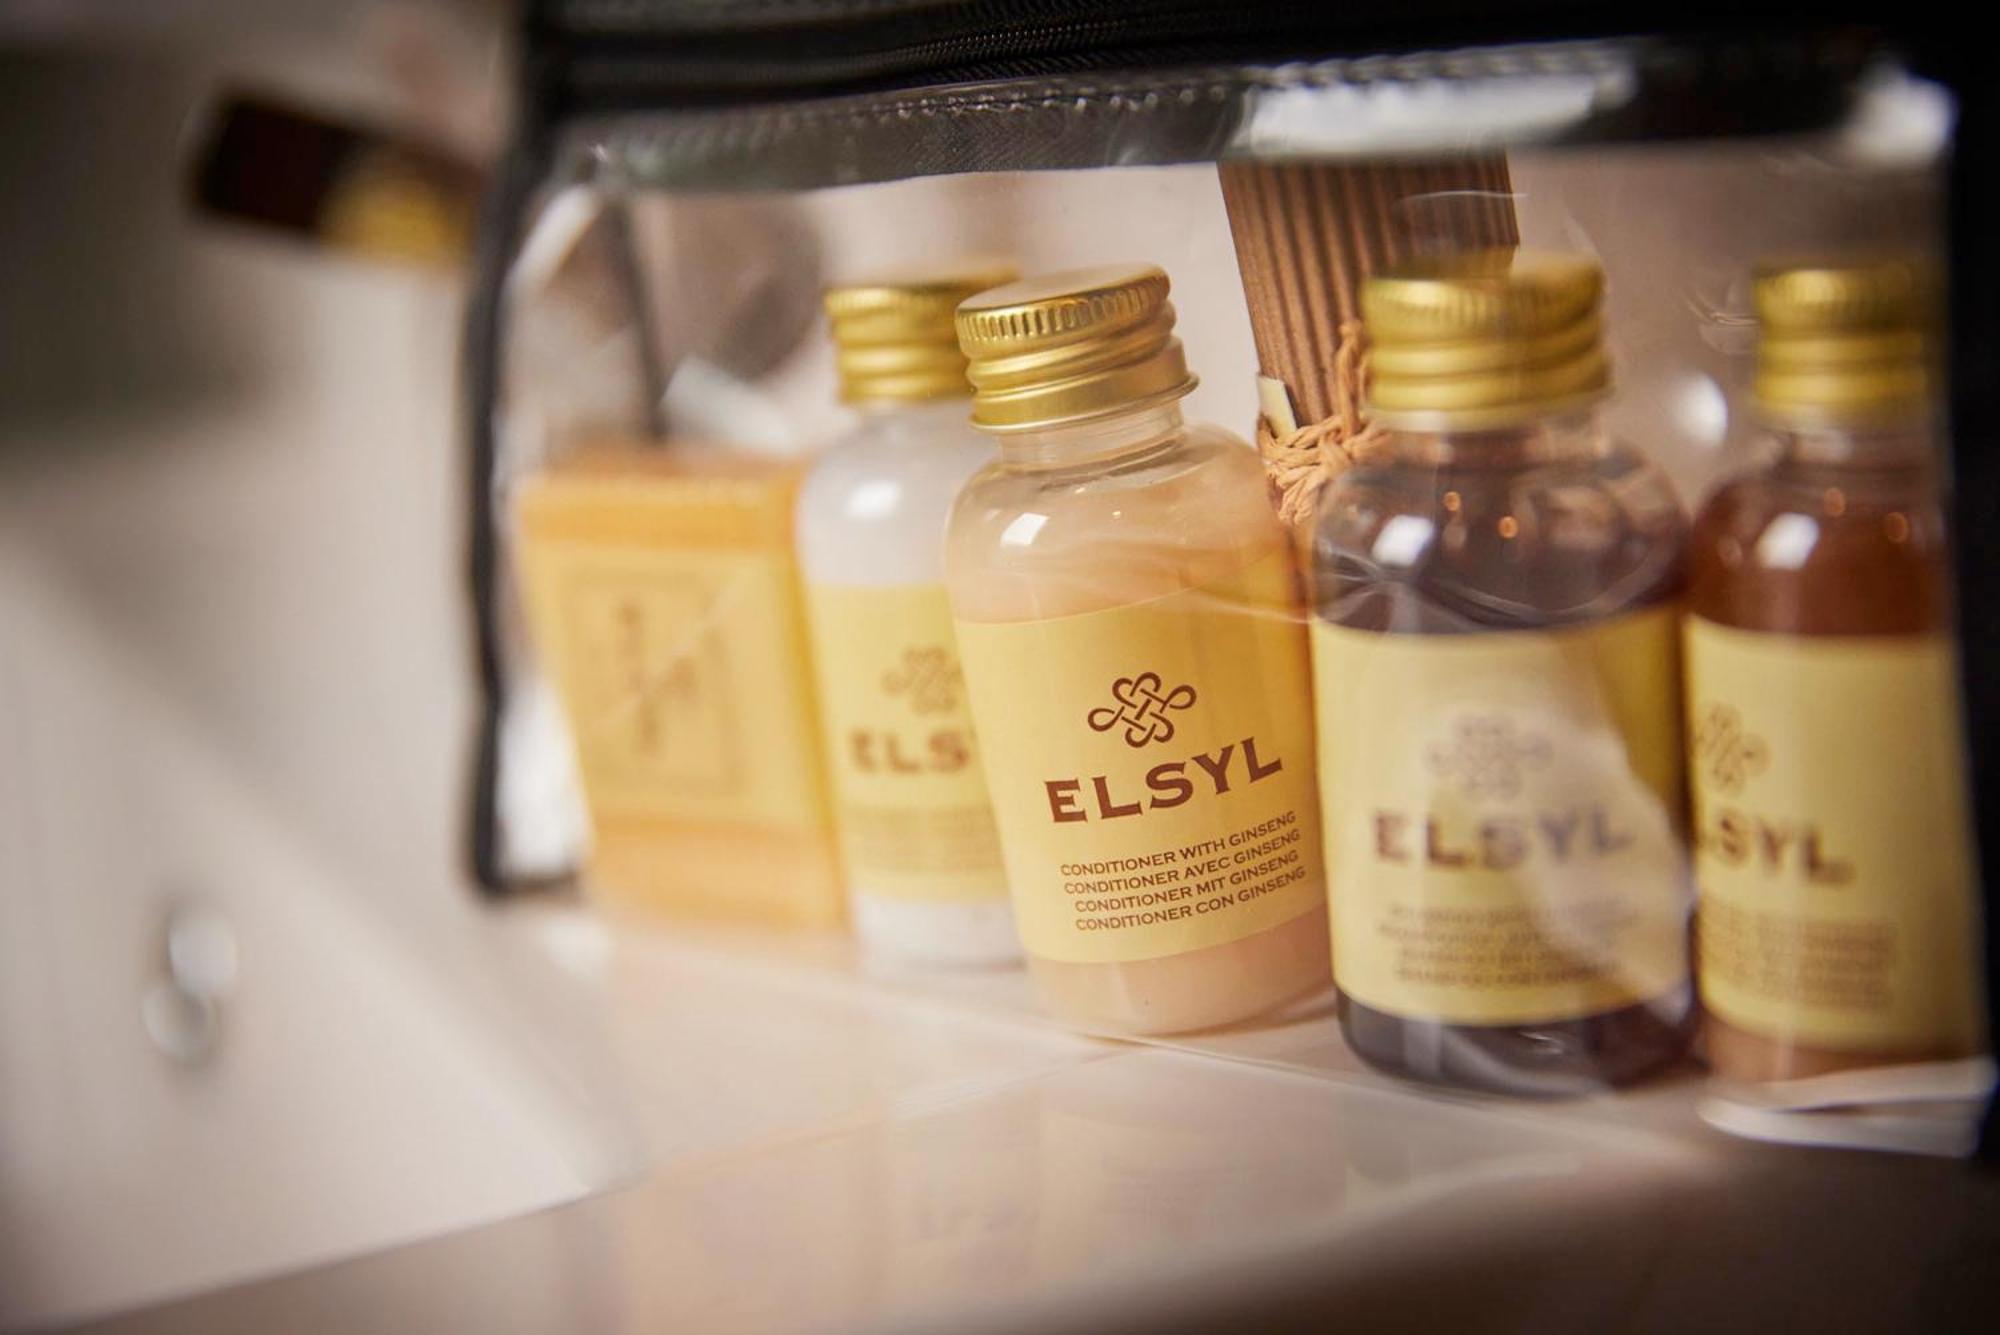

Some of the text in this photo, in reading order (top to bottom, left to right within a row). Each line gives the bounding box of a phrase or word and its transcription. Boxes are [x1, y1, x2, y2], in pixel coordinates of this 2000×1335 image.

[1044, 736, 1283, 823] ELSYL
[1060, 810, 1297, 876] CONDITIONER WITH GINSENG
[1064, 828, 1301, 895] CONDITIONER AVEC GINSENG
[1372, 802, 1636, 872] ELSYL
[1694, 806, 1857, 886] SYL
[1075, 849, 1299, 912] CONDITIONER MIT GINSENG
[1076, 866, 1307, 931] CONDITIONER CON GINSENG
